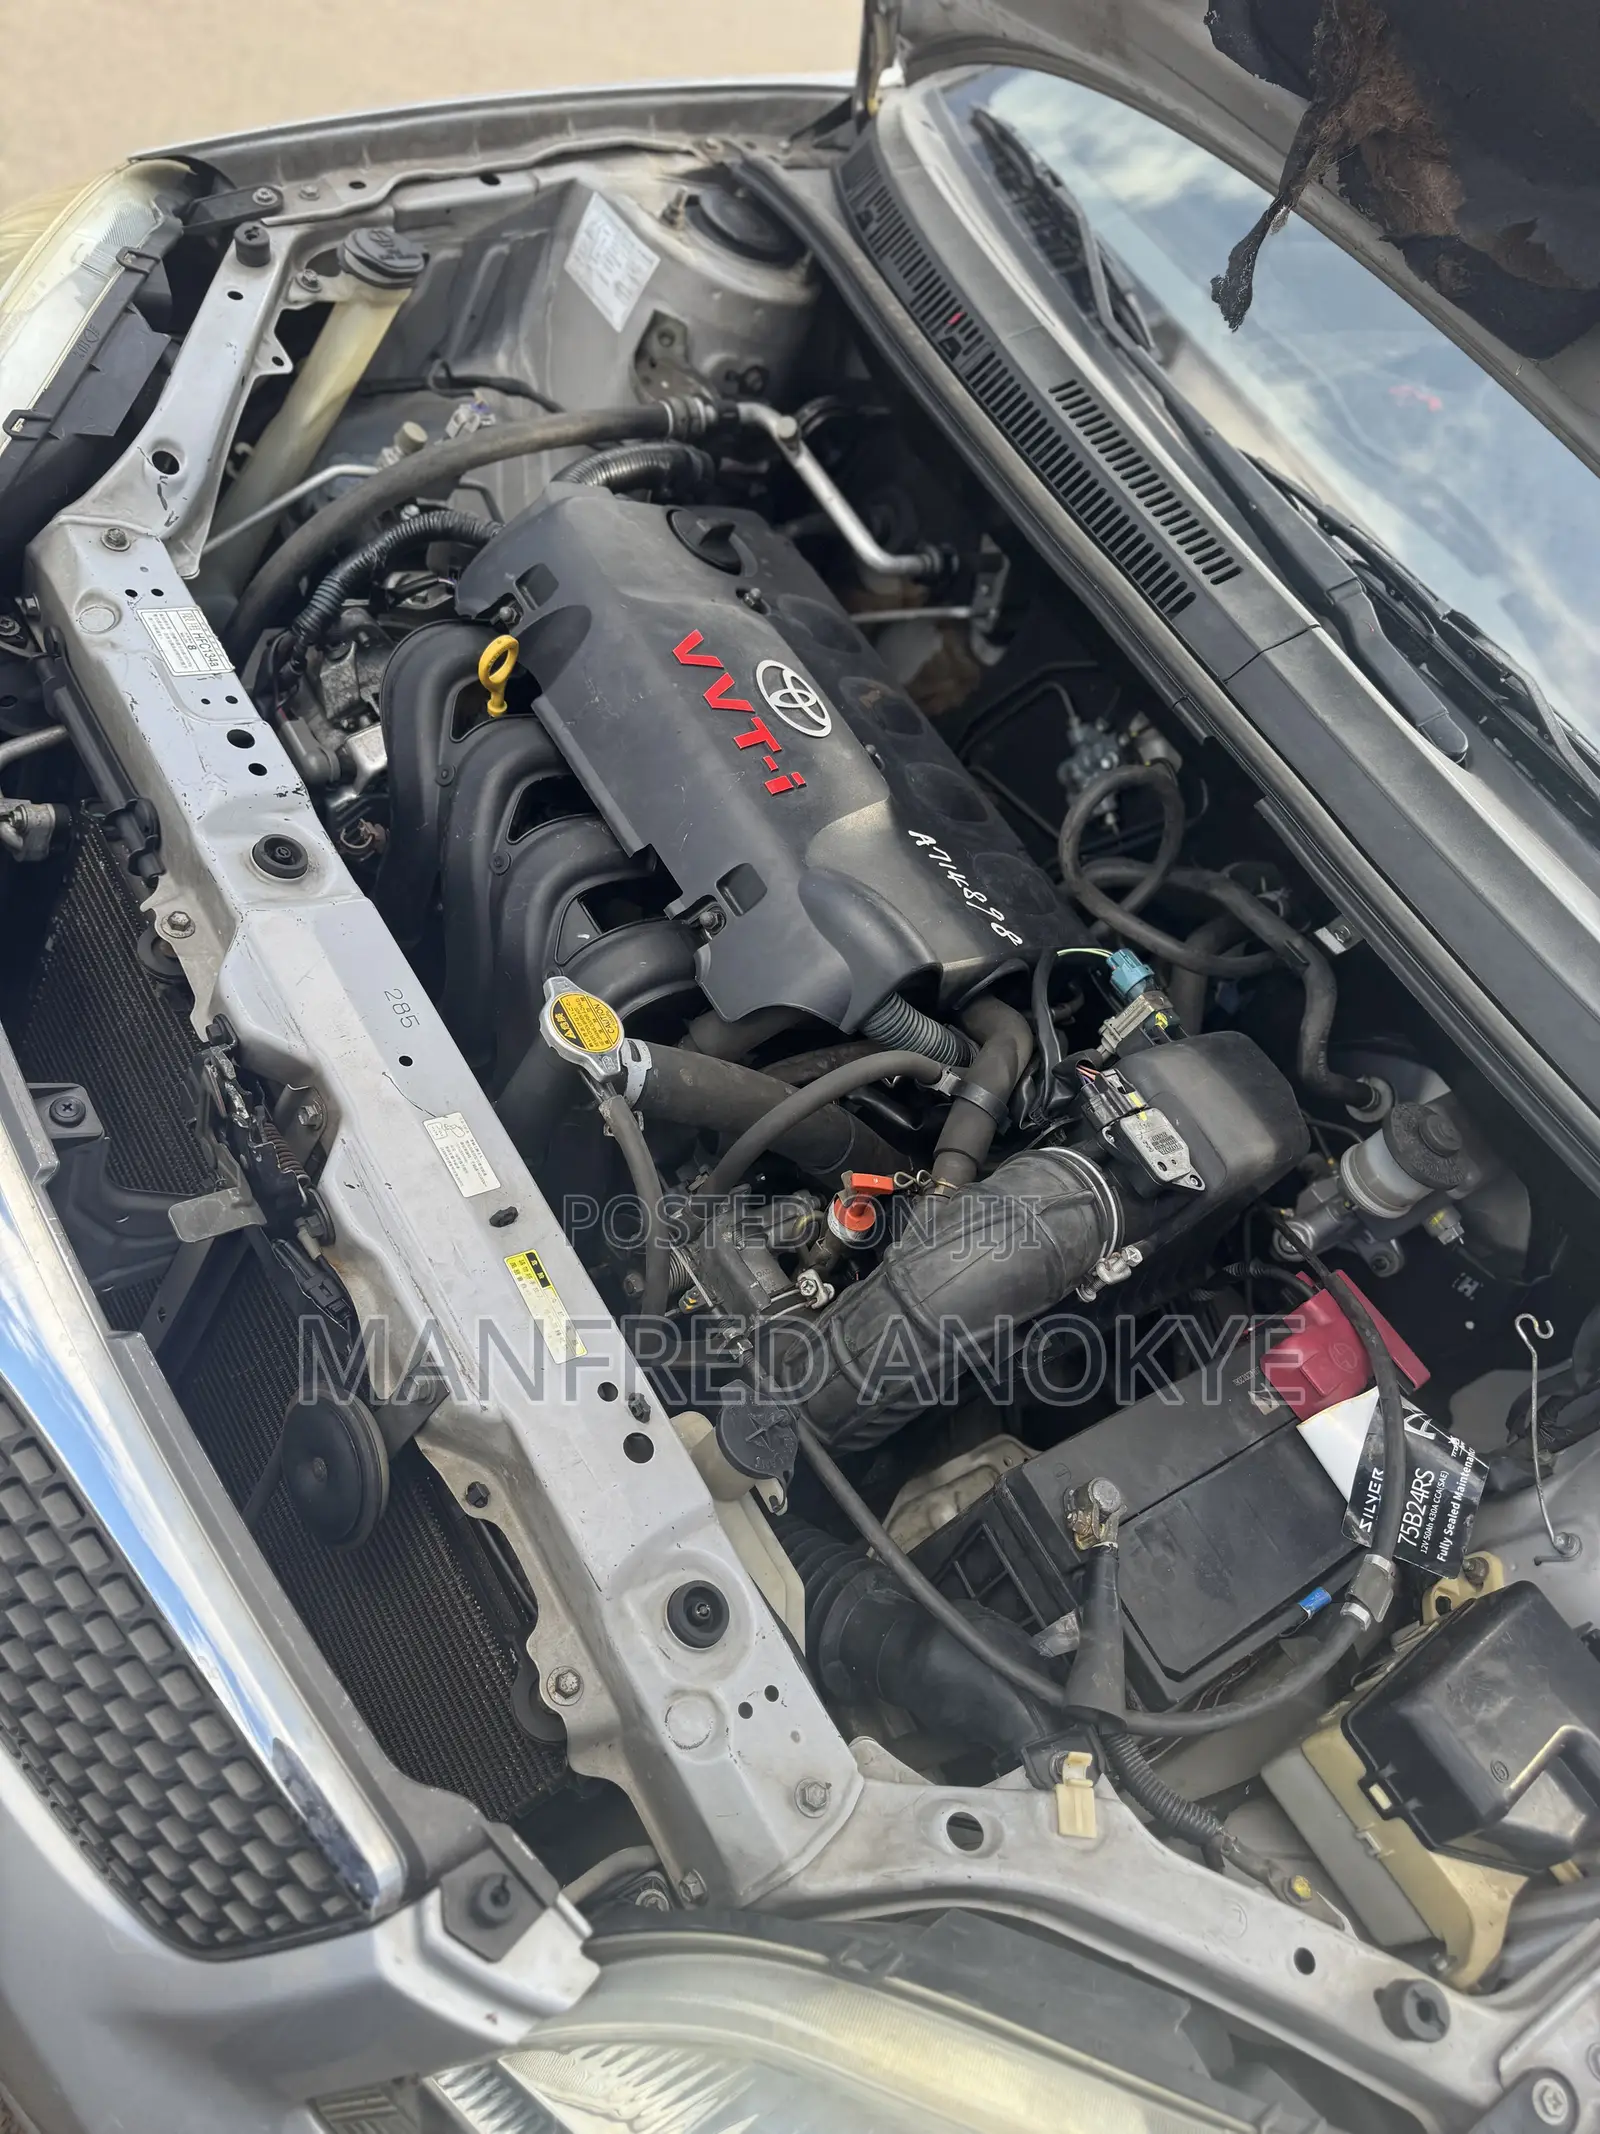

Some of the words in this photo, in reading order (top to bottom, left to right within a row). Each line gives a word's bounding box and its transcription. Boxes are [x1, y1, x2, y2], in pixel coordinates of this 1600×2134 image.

[193, 632, 219, 666] HFC134a
[673, 629, 806, 795] VVT-i
[383, 988, 420, 1028] 285
[594, 1004, 614, 1034] CAUTION
[1359, 1467, 1384, 1533] SILVER
[1433, 1470, 1449, 1504] CCA(SAE)
[1397, 1467, 1435, 1547] 75B24RS
[1428, 1503, 1439, 1522] 430A
[1443, 1502, 1460, 1535] Sealed
[1420, 1535, 1430, 1554] 12V
[1424, 1519, 1434, 1541] 50Ah
[1437, 1536, 1453, 1562] Fully
